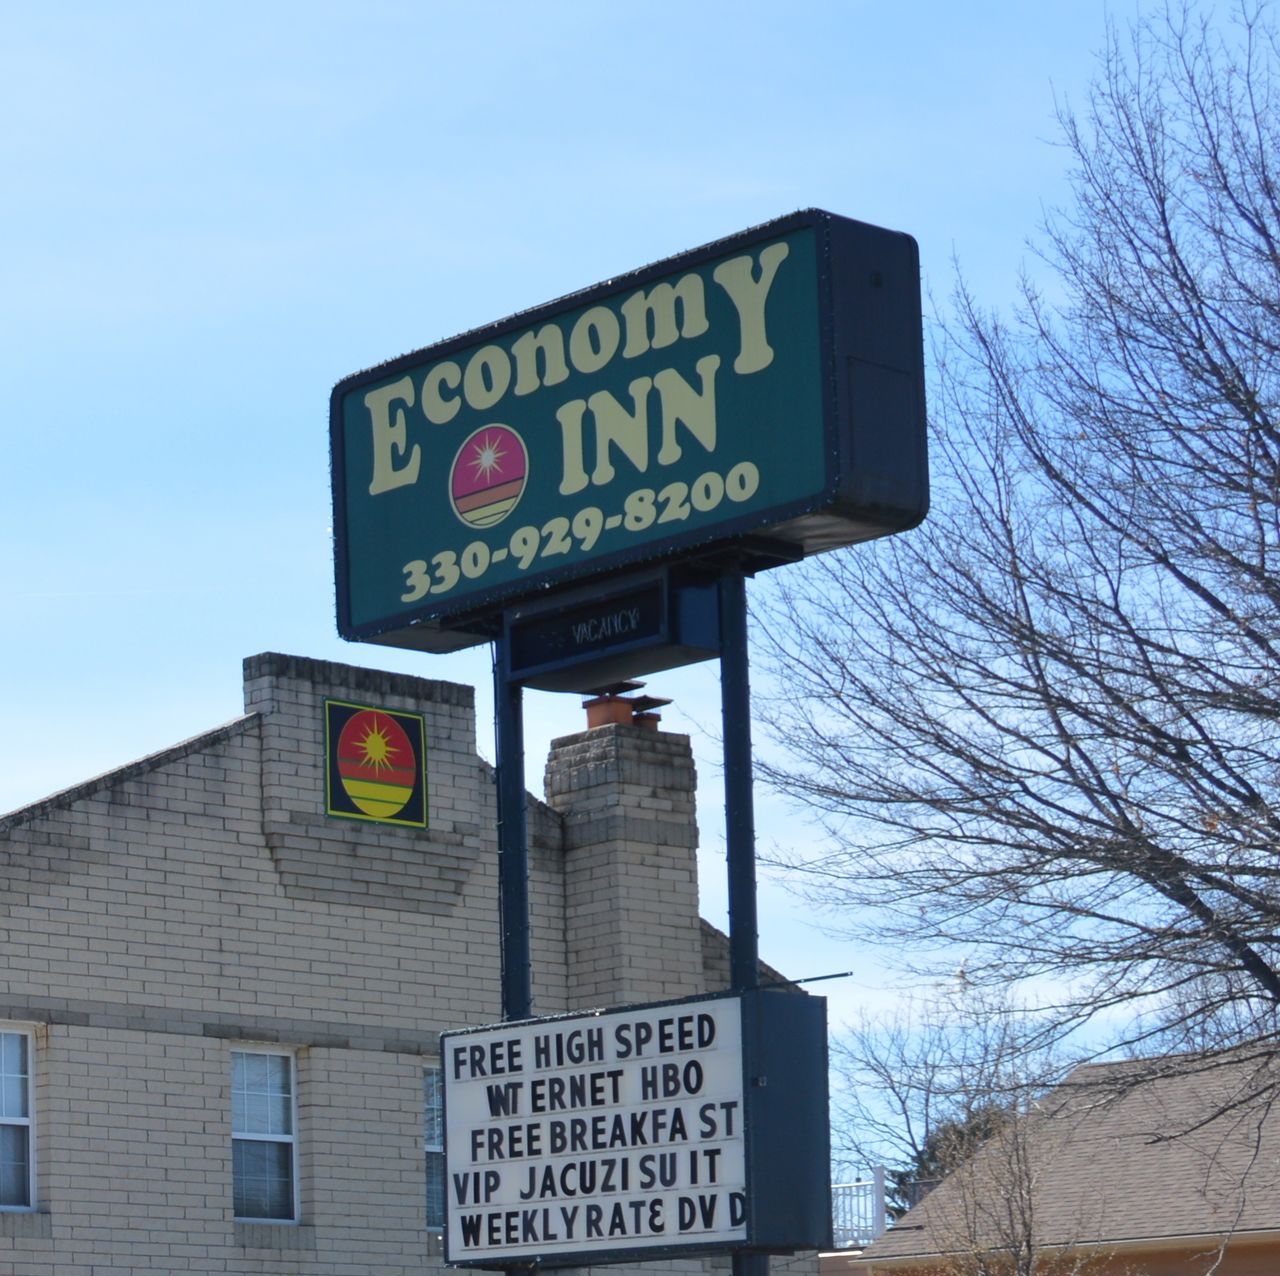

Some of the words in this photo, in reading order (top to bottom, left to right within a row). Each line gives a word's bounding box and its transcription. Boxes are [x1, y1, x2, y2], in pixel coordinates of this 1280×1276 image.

[556, 354, 720, 496] INN
[401, 461, 759, 602] 330-929-8200
[453, 1038, 523, 1079] FREE
[535, 1027, 604, 1069] HIGH
[615, 1013, 716, 1059] SPEED
[641, 1060, 703, 1101] HBO
[471, 1122, 540, 1162] FREE
[453, 1170, 500, 1205] VIP
[519, 1157, 629, 1200] JACUZI
[460, 1205, 579, 1247] WEEKLY
